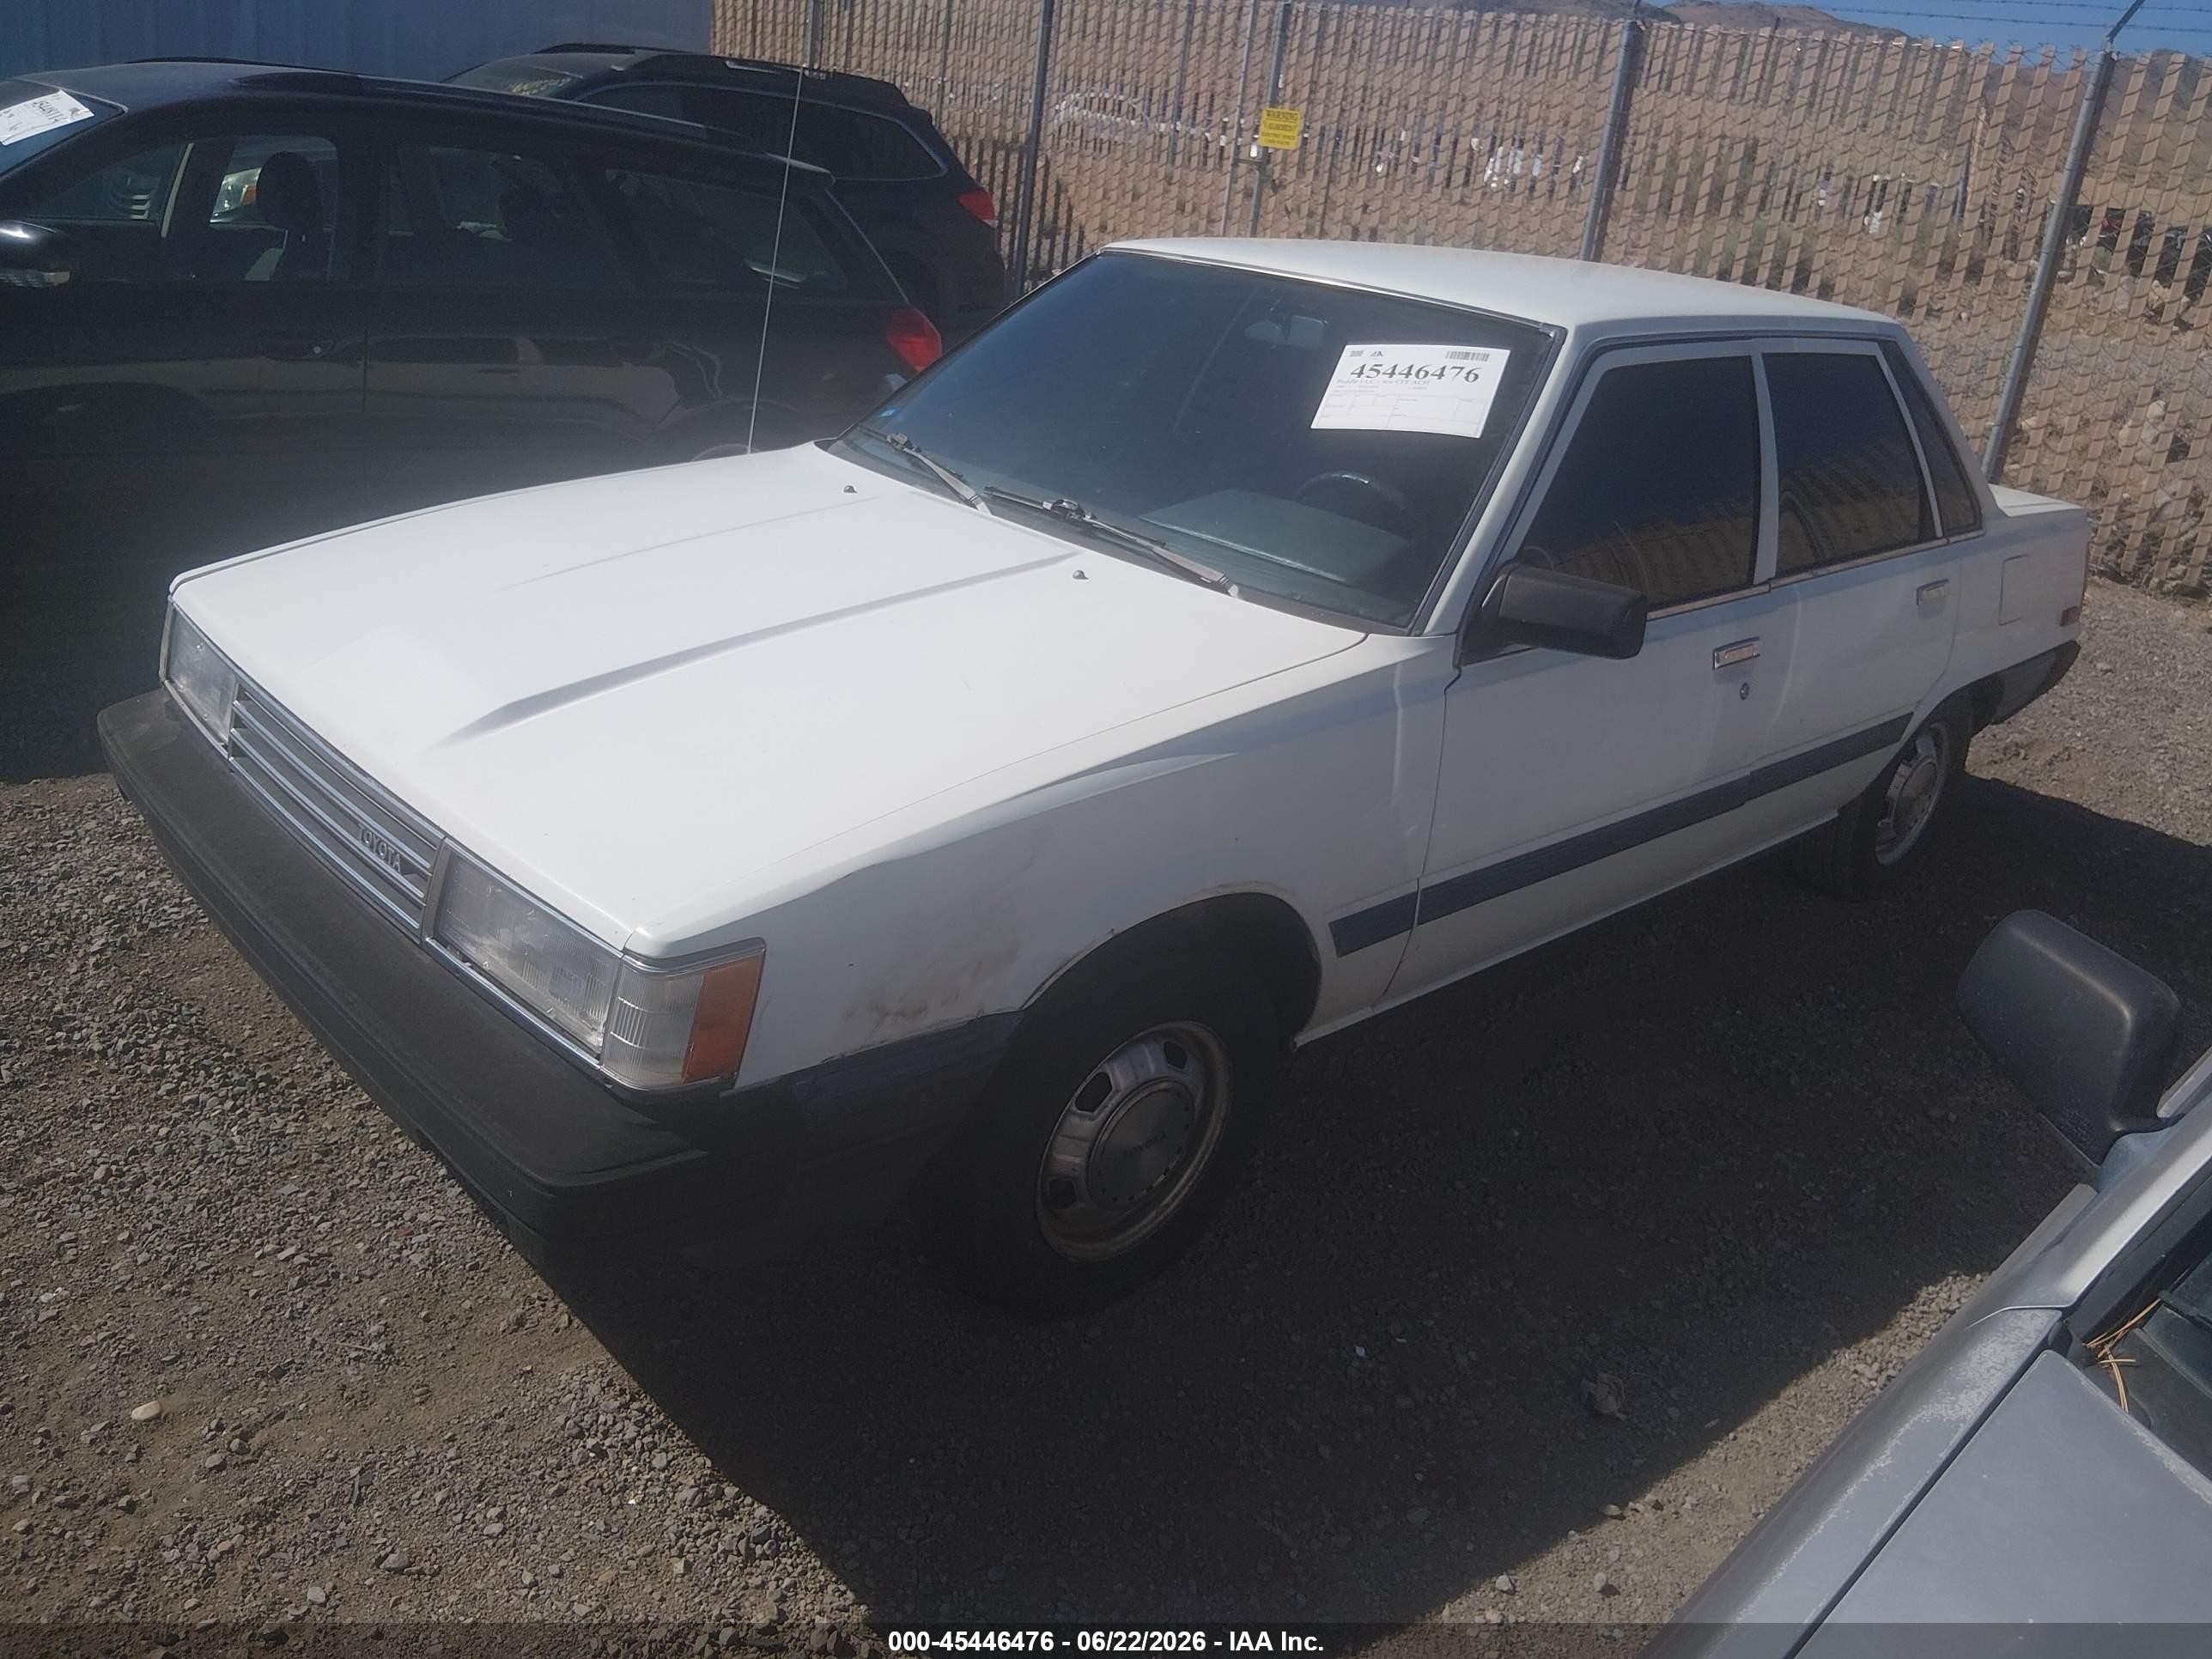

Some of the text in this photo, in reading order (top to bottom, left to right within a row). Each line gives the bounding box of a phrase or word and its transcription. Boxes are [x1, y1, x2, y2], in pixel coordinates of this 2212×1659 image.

[1266, 109, 1298, 121] WARNING
[1351, 363, 1482, 383] 45446476
[357, 823, 402, 873] TOYOTA
